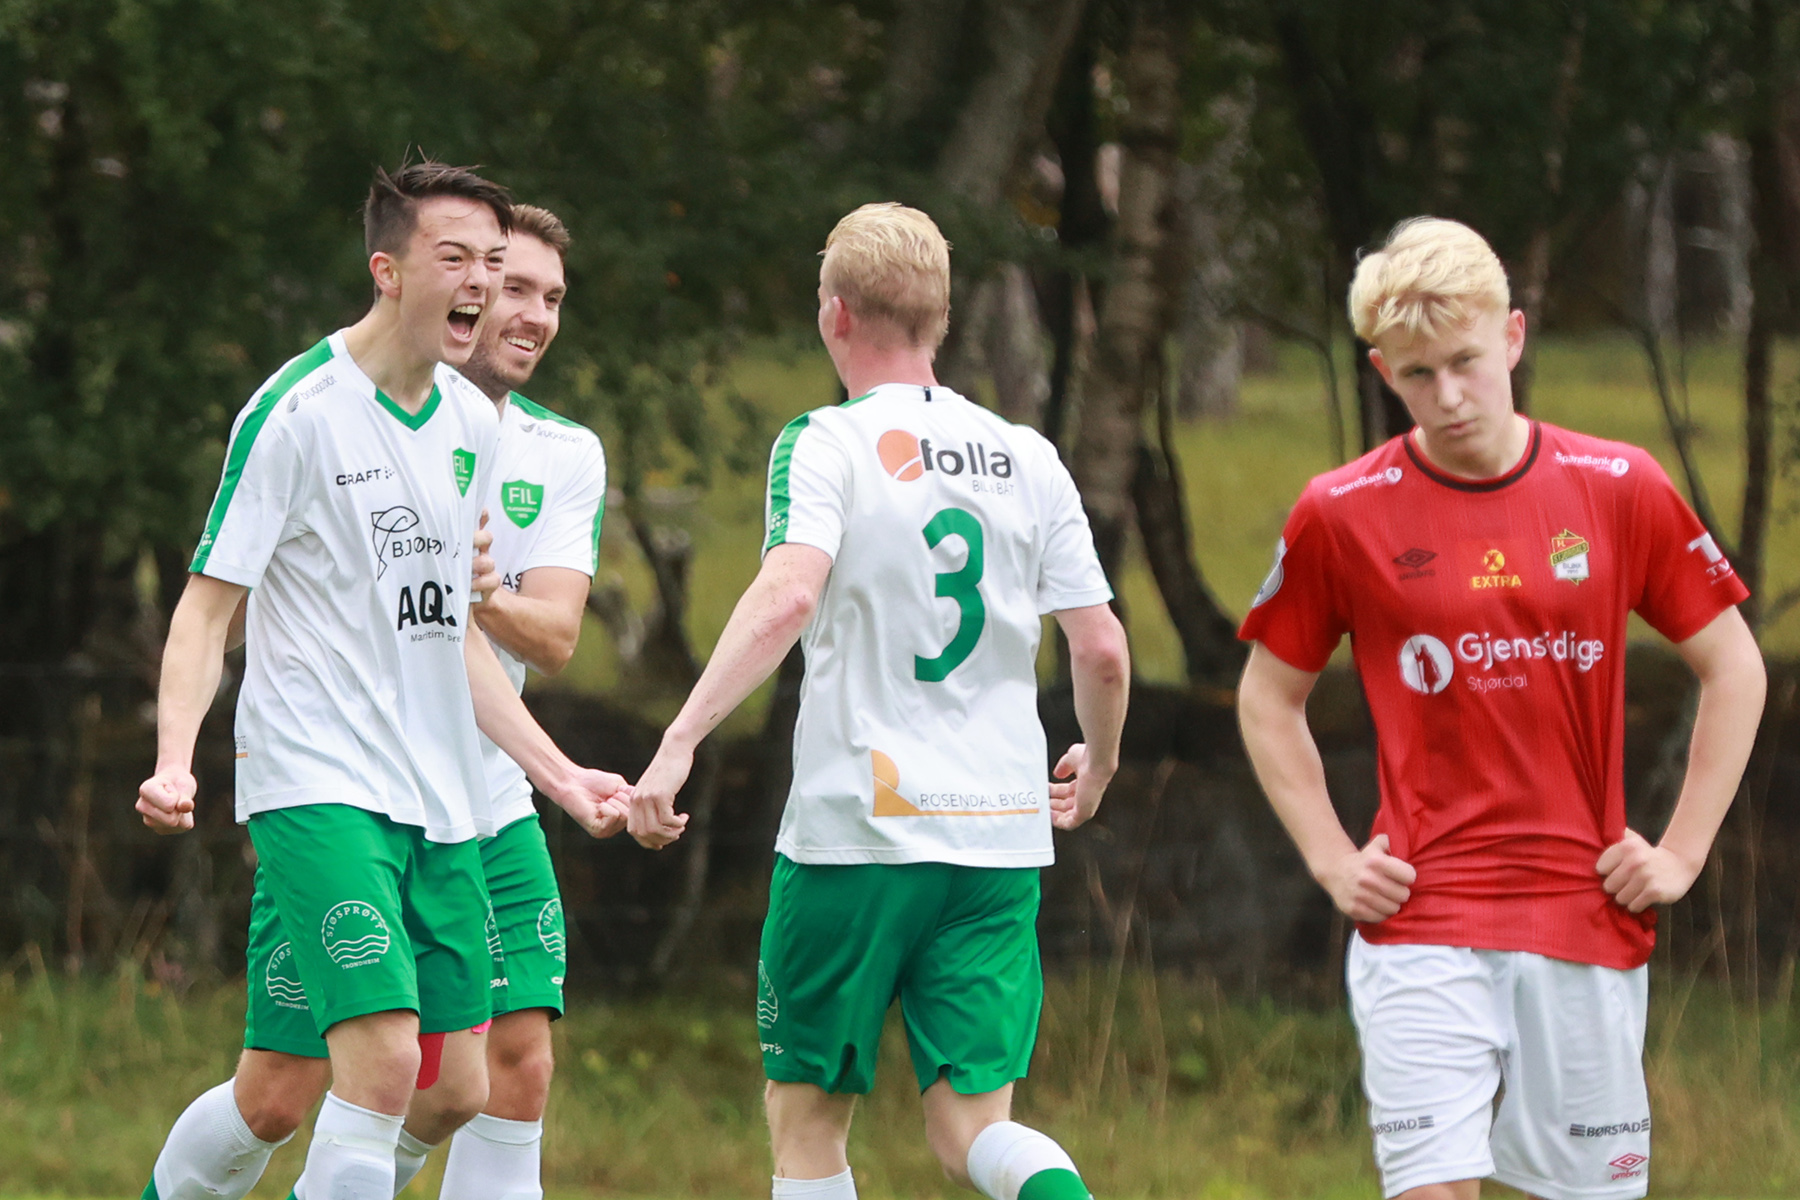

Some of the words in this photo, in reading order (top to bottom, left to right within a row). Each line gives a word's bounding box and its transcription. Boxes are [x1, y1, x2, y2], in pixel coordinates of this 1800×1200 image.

[920, 438, 1012, 479] folla
[1554, 451, 1611, 466] SpareBank
[336, 469, 381, 486] CRAFT
[1330, 472, 1386, 497] SpareBank
[508, 487, 538, 506] FIL
[1471, 575, 1522, 589] EXTRA
[914, 507, 986, 683] 3
[410, 630, 445, 642] Maritim
[1457, 631, 1605, 671] Gjensidige
[1467, 673, 1528, 693] Stjørdal
[920, 792, 997, 808] ROSENDAL
[999, 791, 1038, 807] BYGG
[1375, 1118, 1418, 1135] ØRSTAD
[1586, 1122, 1641, 1137] BØRSTAD
